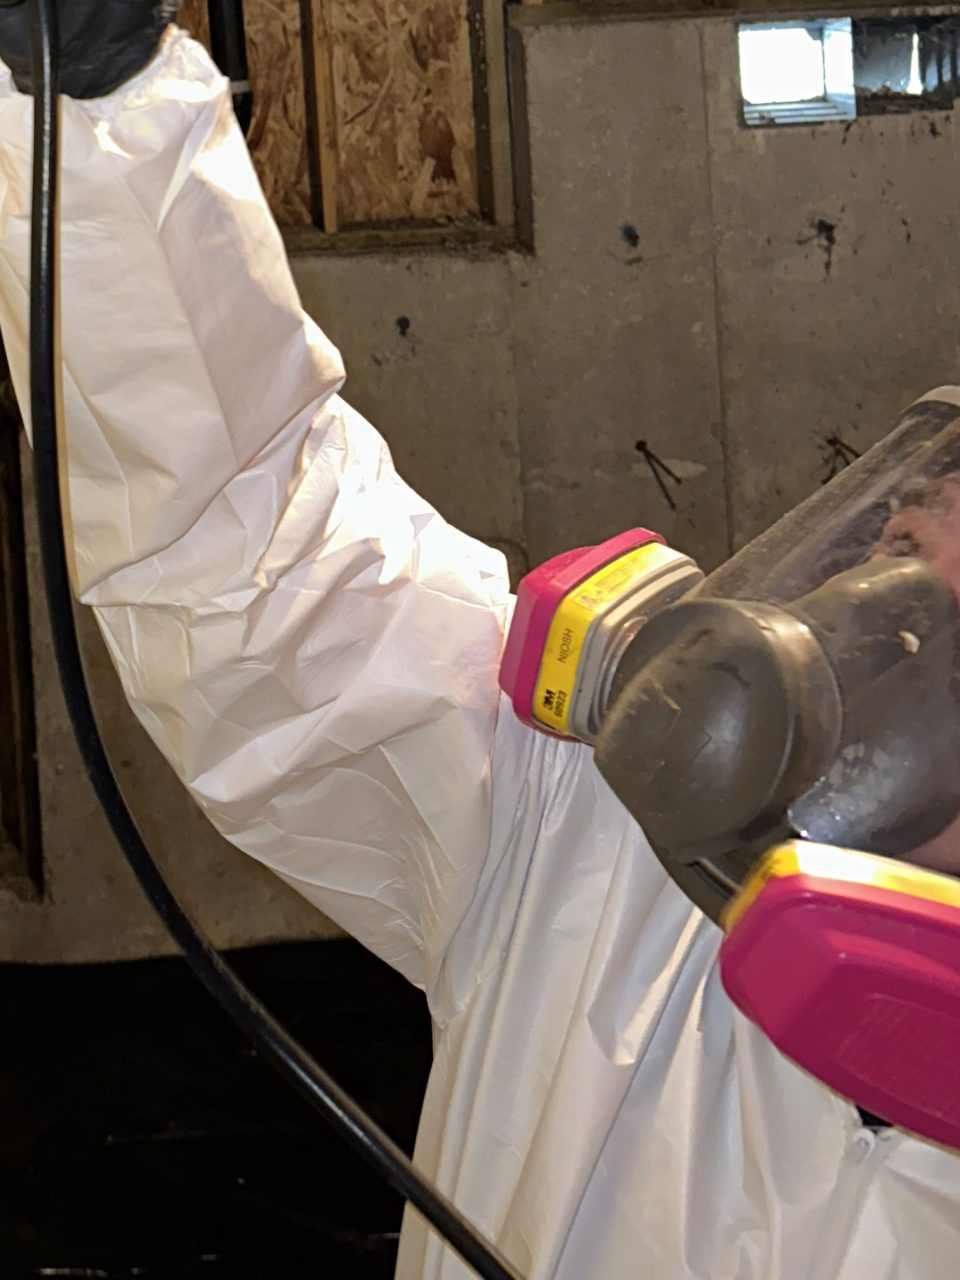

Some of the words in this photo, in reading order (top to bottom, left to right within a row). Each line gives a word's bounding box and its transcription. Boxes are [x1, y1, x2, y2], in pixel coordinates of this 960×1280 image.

[558, 628, 573, 663] NIOSH
[543, 689, 556, 710] 3M
[554, 690, 567, 717] 60923
